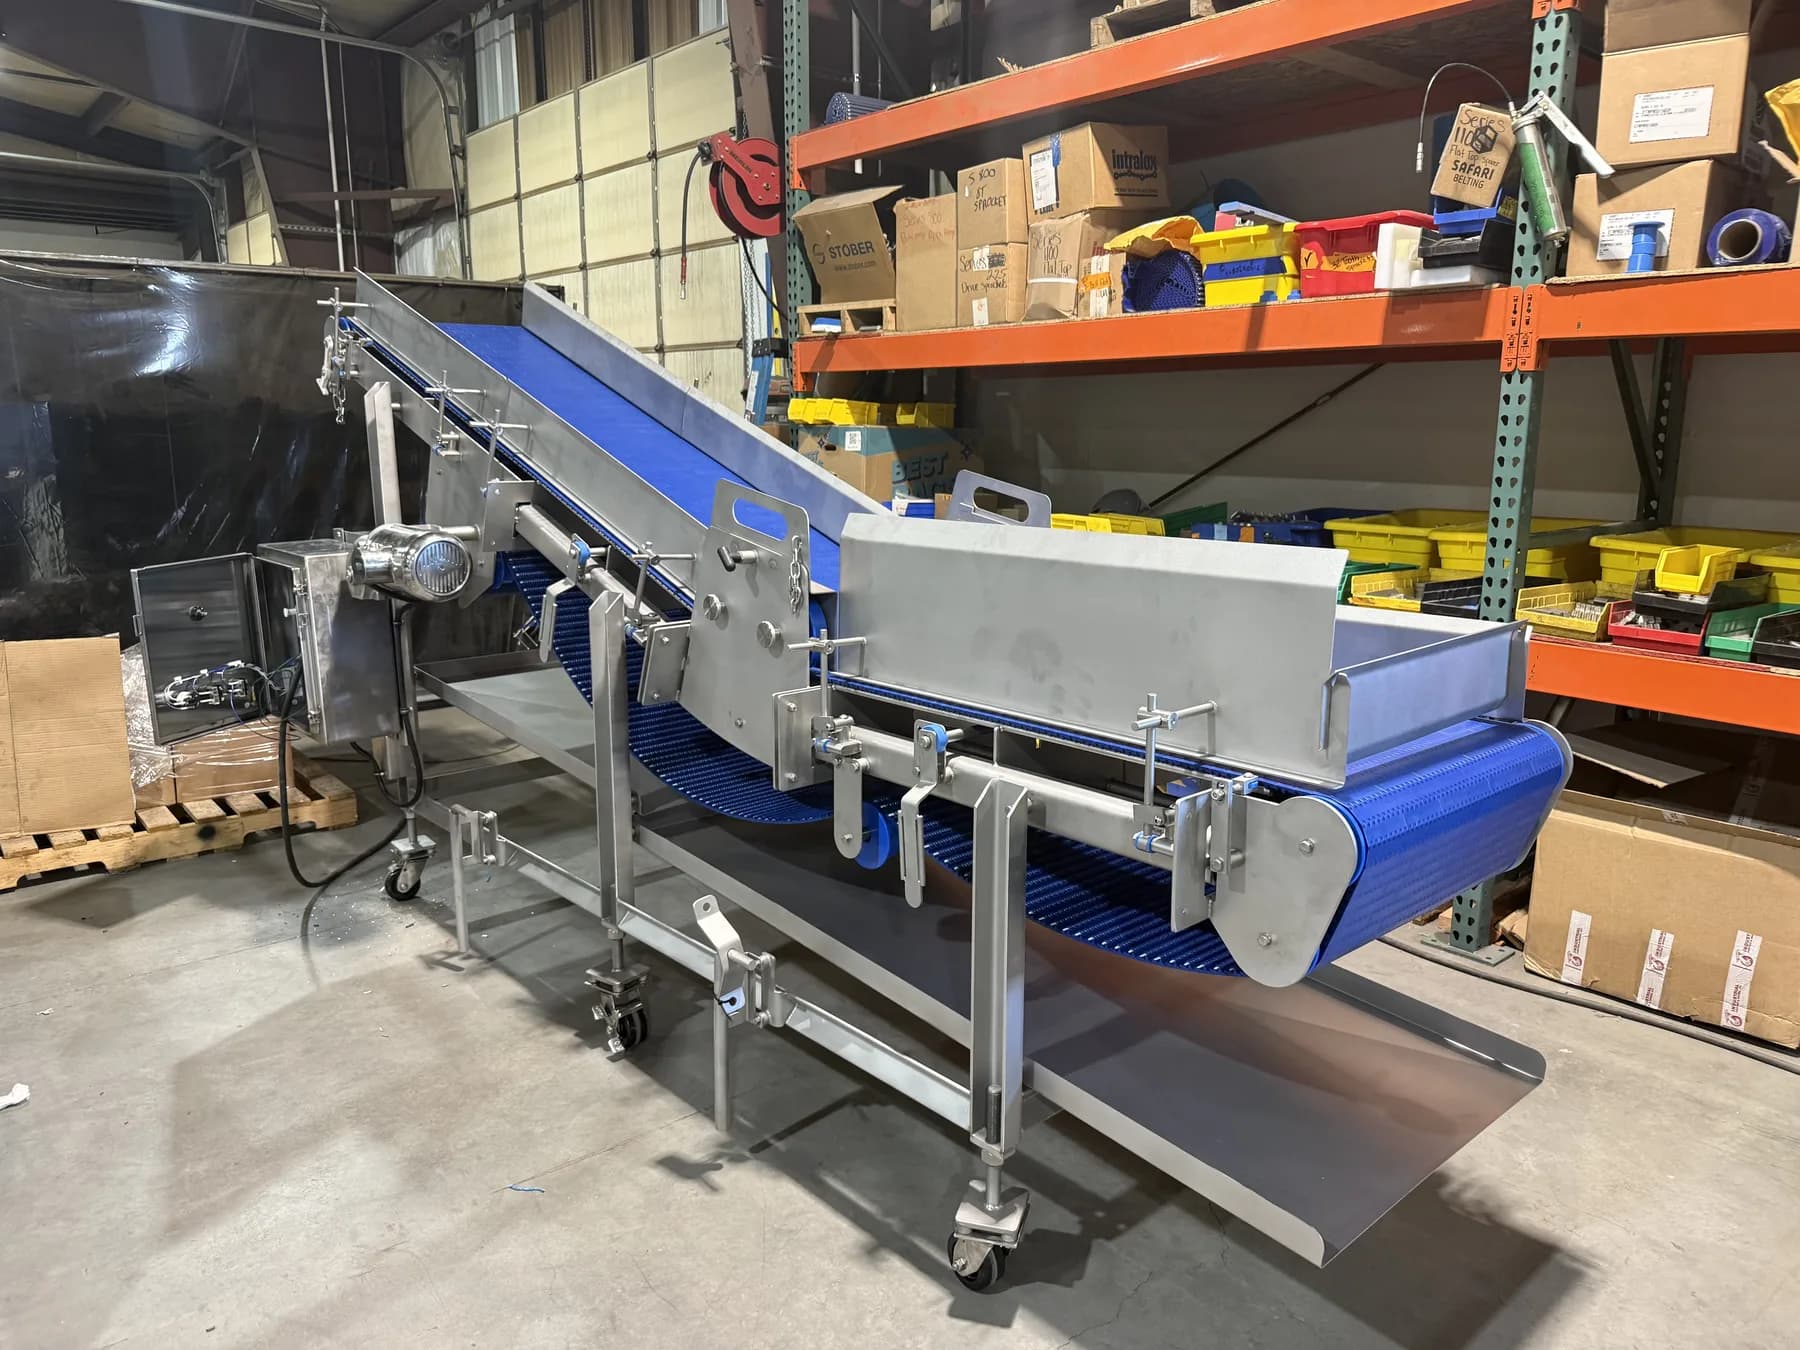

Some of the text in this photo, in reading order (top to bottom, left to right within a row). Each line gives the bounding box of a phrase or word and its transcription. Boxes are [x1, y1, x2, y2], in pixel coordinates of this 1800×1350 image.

[1460, 109, 1505, 133] Series
[1112, 149, 1157, 171] intralox
[1449, 144, 1465, 158] Flat
[1467, 150, 1479, 166] Top
[1451, 159, 1495, 181] SAFARI
[1453, 173, 1485, 189] BELTING
[973, 194, 1008, 213] SPROCKET
[828, 240, 874, 259] STOBER
[959, 255, 988, 273] Series
[892, 451, 949, 484] BEST
